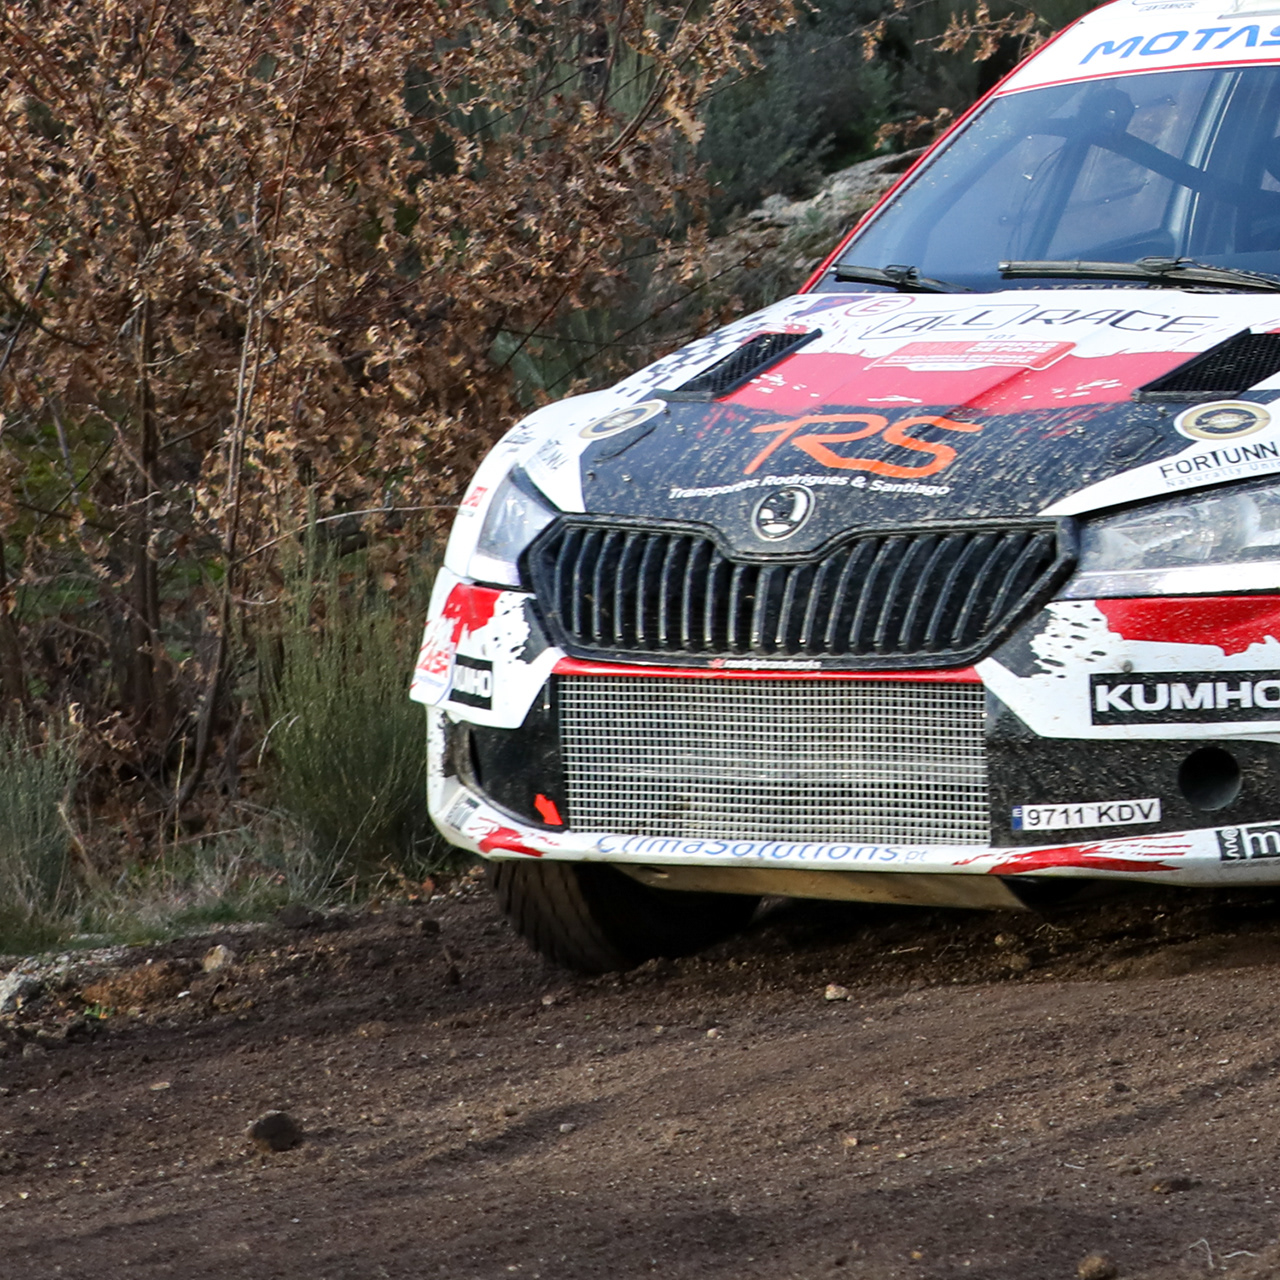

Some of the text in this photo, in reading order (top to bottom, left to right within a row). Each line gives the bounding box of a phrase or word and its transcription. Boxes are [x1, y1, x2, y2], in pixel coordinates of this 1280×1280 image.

[744, 413, 984, 480] RS
[760, 472, 849, 487] Rodrigues
[850, 475, 867, 488] &
[868, 479, 950, 496] Santiago
[1166, 466, 1242, 489] Naturally
[1027, 807, 1085, 826] 9711
[1097, 802, 1154, 823] KDV
